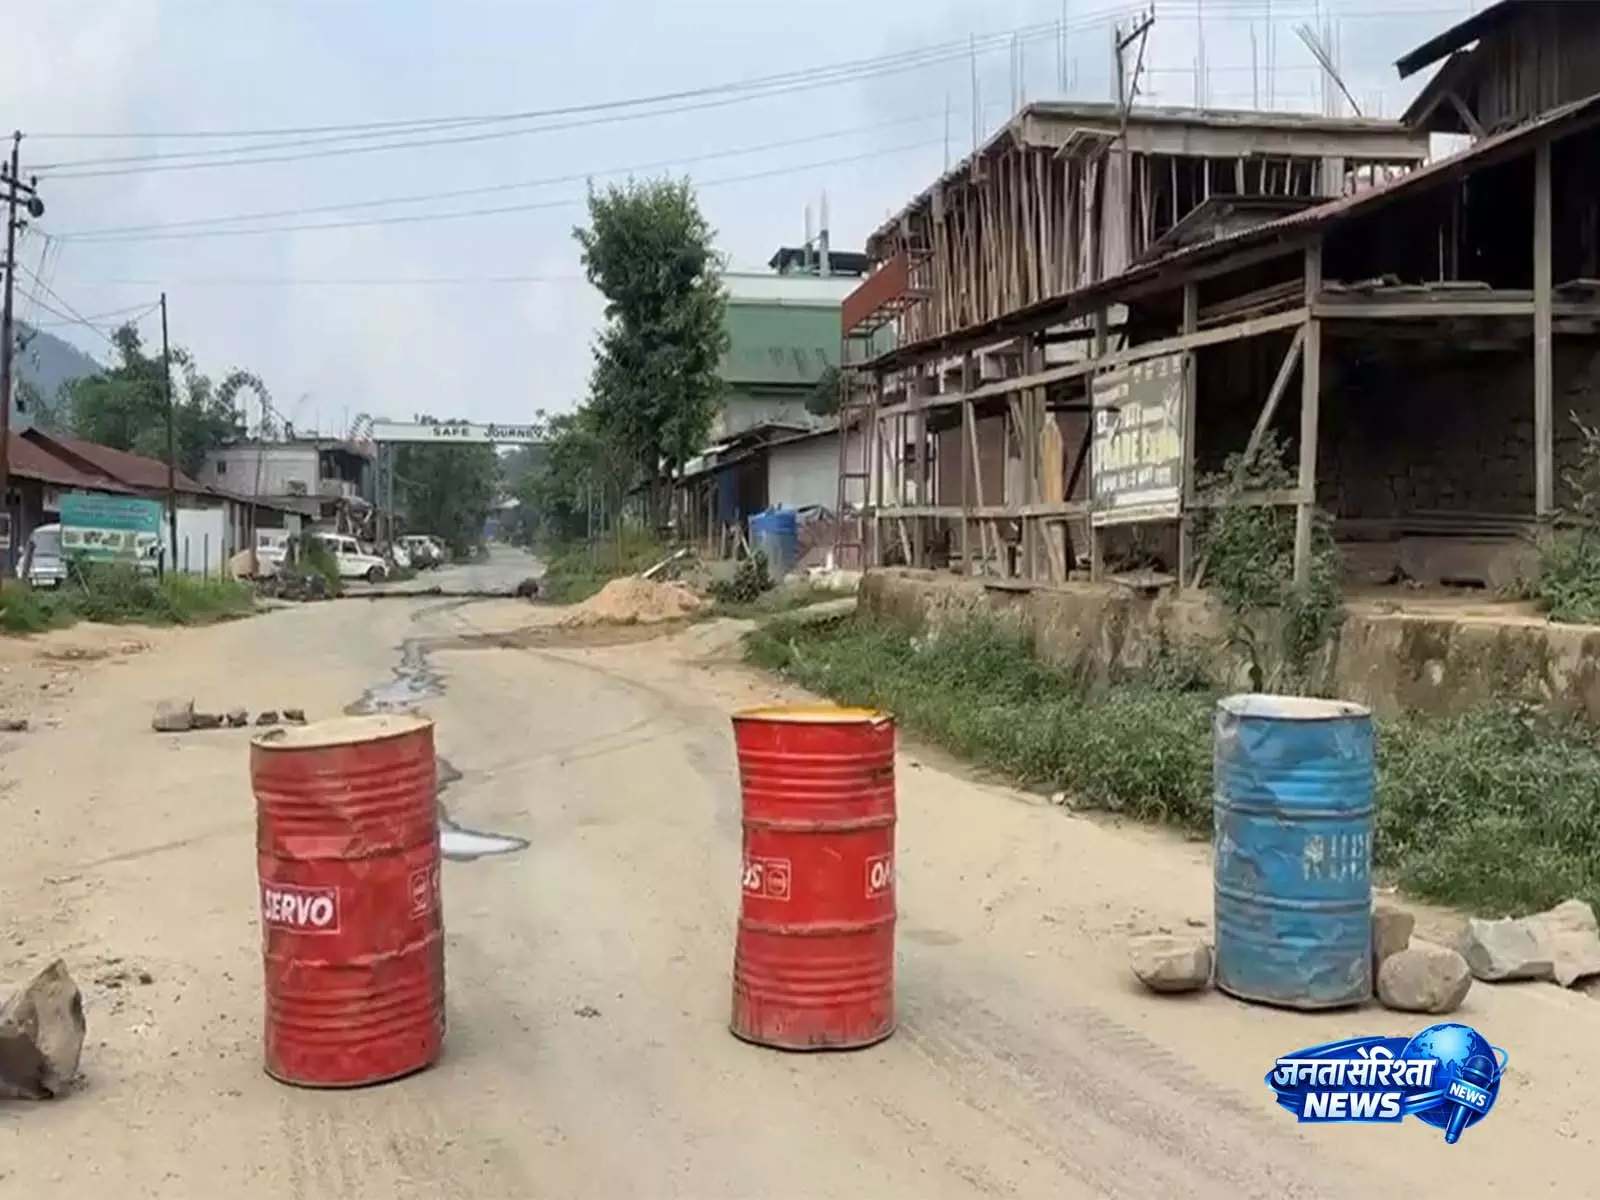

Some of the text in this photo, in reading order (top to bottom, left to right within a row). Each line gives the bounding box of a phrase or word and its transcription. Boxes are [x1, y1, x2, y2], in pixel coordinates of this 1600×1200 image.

[432, 425, 543, 438] SAFE JOURNEY
[264, 888, 334, 926] SERVO
